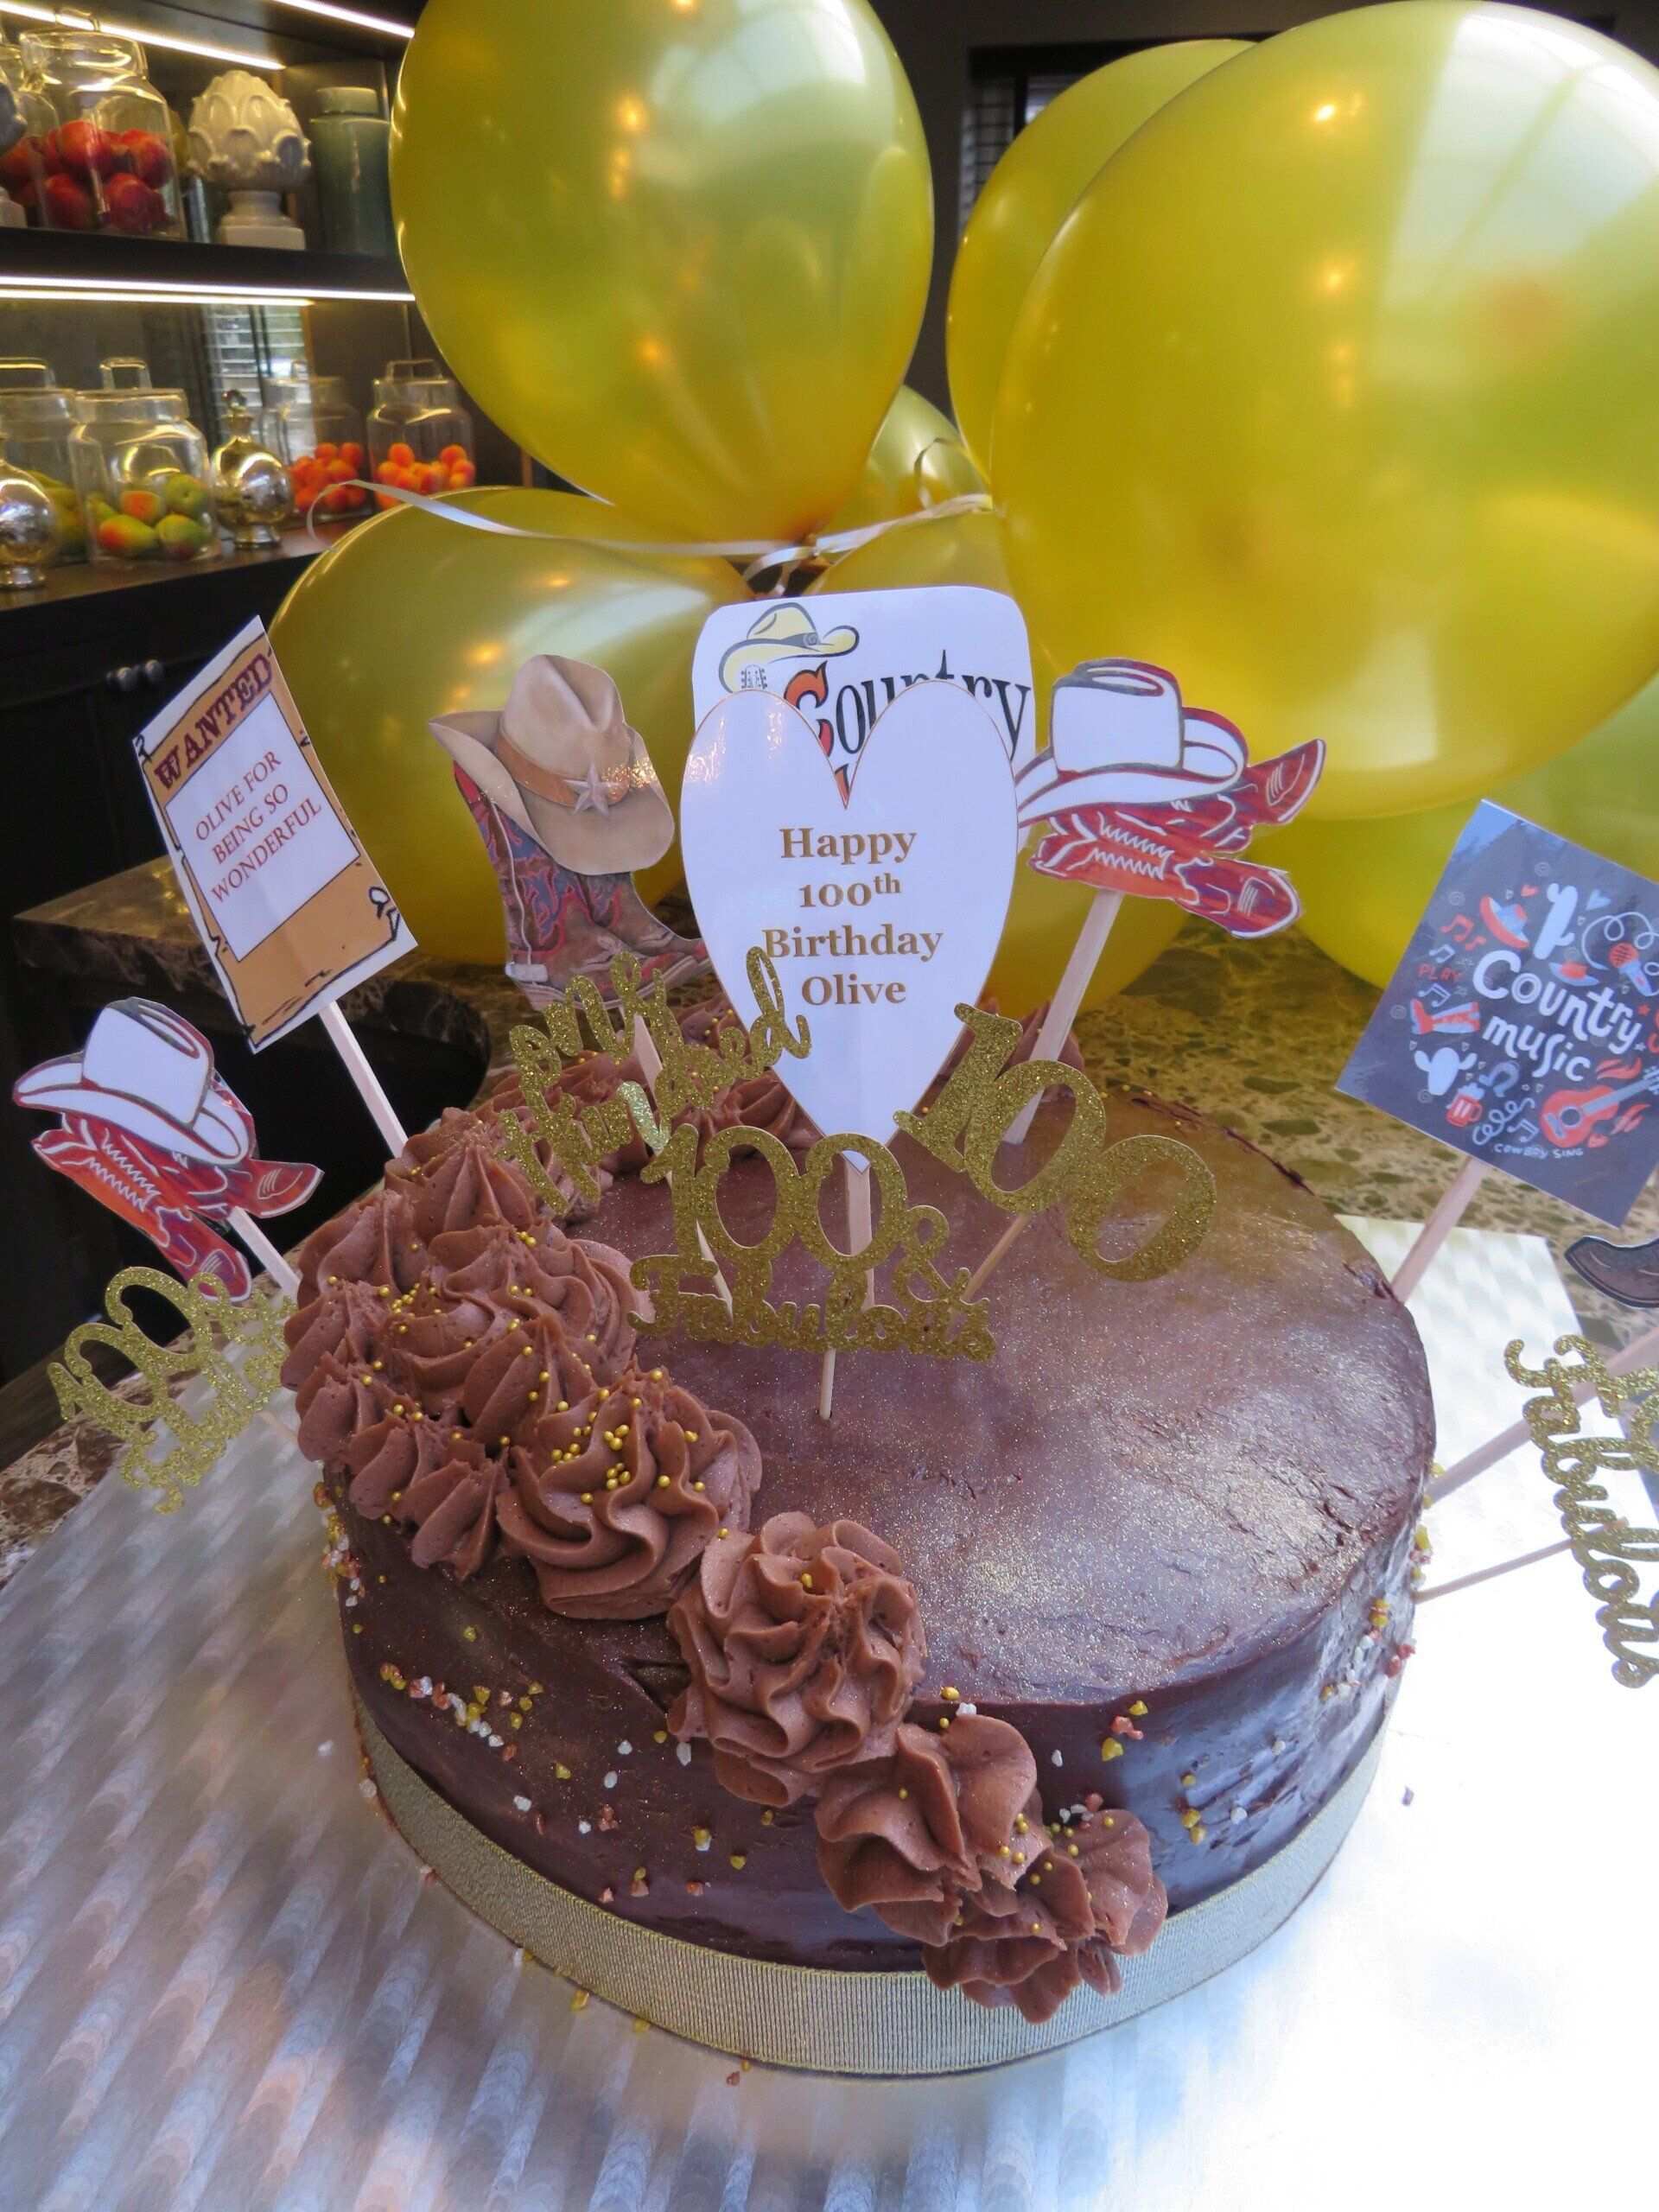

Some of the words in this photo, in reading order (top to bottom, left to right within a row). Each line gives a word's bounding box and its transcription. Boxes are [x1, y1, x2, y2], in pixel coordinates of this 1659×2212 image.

[154, 653, 274, 790] WANTED
[195, 785, 245, 841] OLIVE
[243, 751, 282, 795] FOR
[211, 807, 264, 864] BEING
[264, 784, 289, 815] SO
[210, 798, 322, 903] WONDERFUL
[779, 827, 917, 863] Happy
[798, 873, 901, 908] 100th
[761, 923, 944, 962] Birthday
[1417, 963, 1462, 982] PLAY
[801, 974, 906, 1006] Olive
[1472, 950, 1642, 1054] Country
[1482, 1015, 1592, 1081] music
[893, 1002, 1216, 1282] 100
[640, 1123, 907, 1272] 100
[893, 1205, 991, 1305] &
[627, 1255, 997, 1362] Fabulous
[47, 1267, 212, 1441] 100
